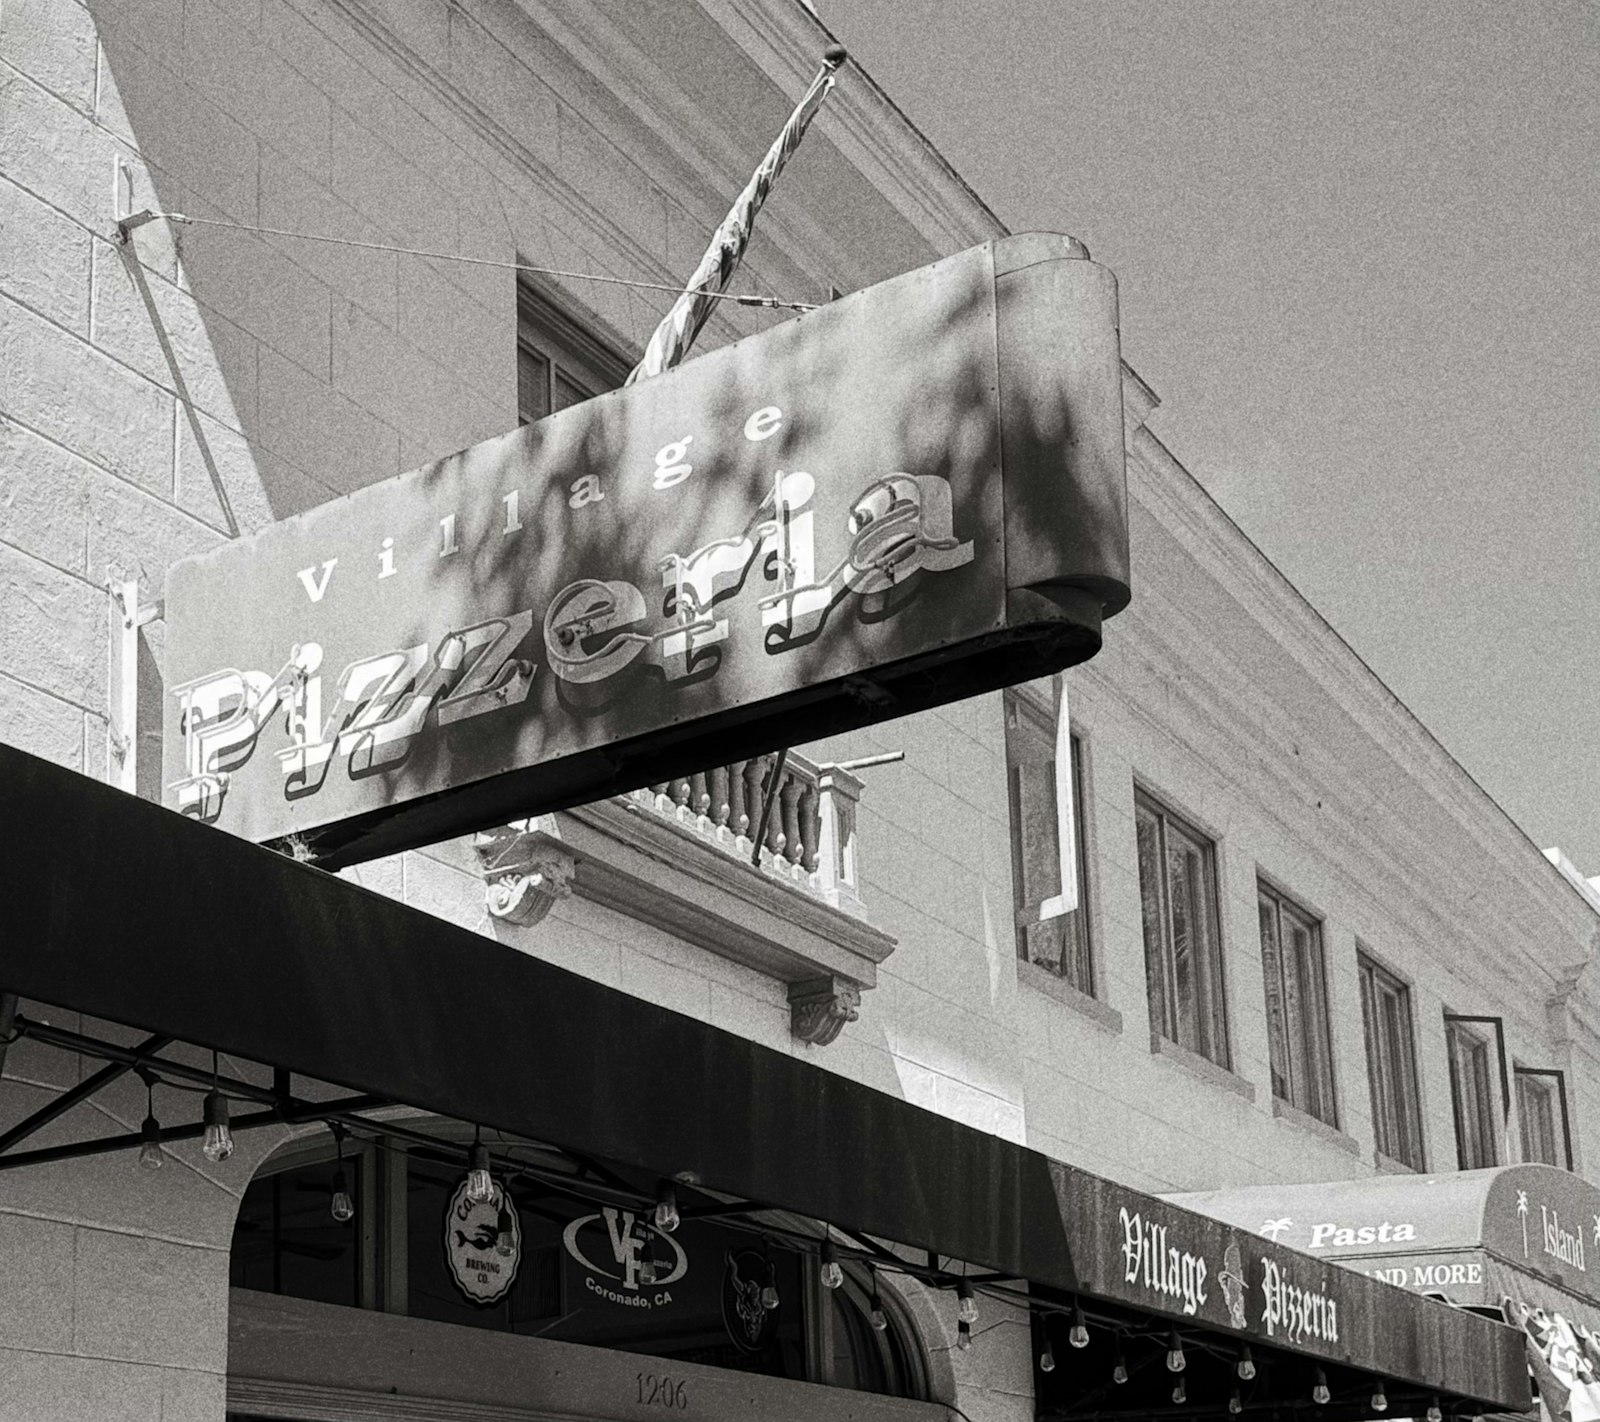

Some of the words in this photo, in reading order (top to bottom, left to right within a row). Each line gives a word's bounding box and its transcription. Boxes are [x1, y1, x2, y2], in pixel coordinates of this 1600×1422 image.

[170, 470, 974, 806] Pizzeria
[1308, 1221, 1417, 1248] Pasta
[1541, 1205, 1585, 1271] Island
[466, 1258, 500, 1274] BREWING
[1119, 1206, 1207, 1315] Village
[1364, 1268, 1407, 1287] ND
[1414, 1263, 1482, 1287] MORE
[585, 1277, 651, 1309] Coronado,
[654, 1291, 672, 1306] CA
[1260, 1256, 1339, 1344] Pizzeria
[636, 1373, 687, 1409] 1206
